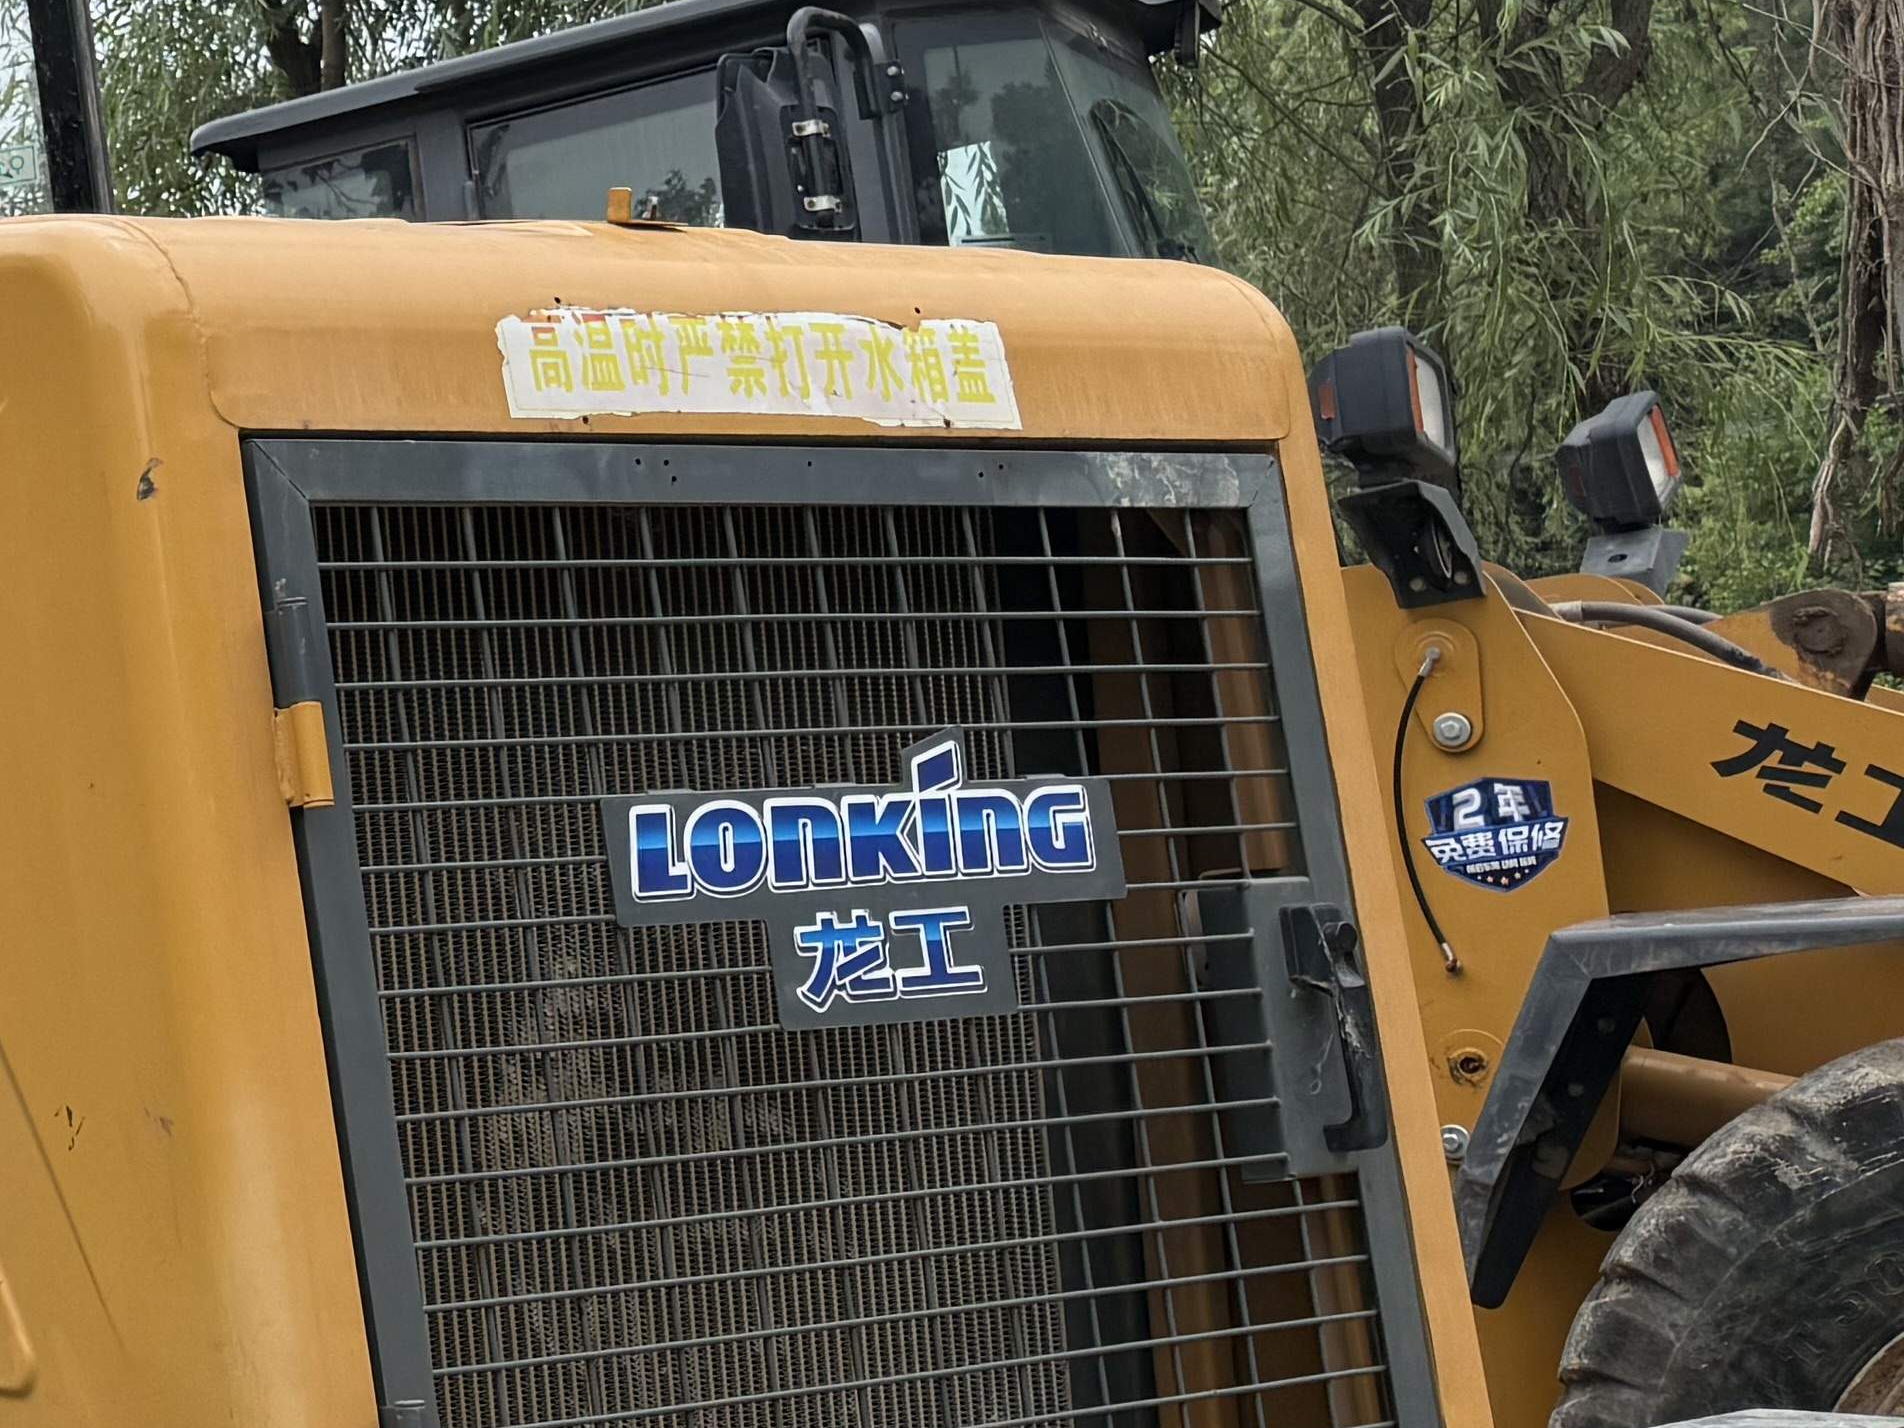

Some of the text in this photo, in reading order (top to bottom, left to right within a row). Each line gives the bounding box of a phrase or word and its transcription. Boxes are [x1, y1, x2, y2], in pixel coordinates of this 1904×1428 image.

[529, 315, 996, 405] 高温时严禁打开水箱盖
[1452, 783, 1530, 831] 2年
[1425, 821, 1564, 863] 免费保修
[794, 905, 988, 1013] 龙工
